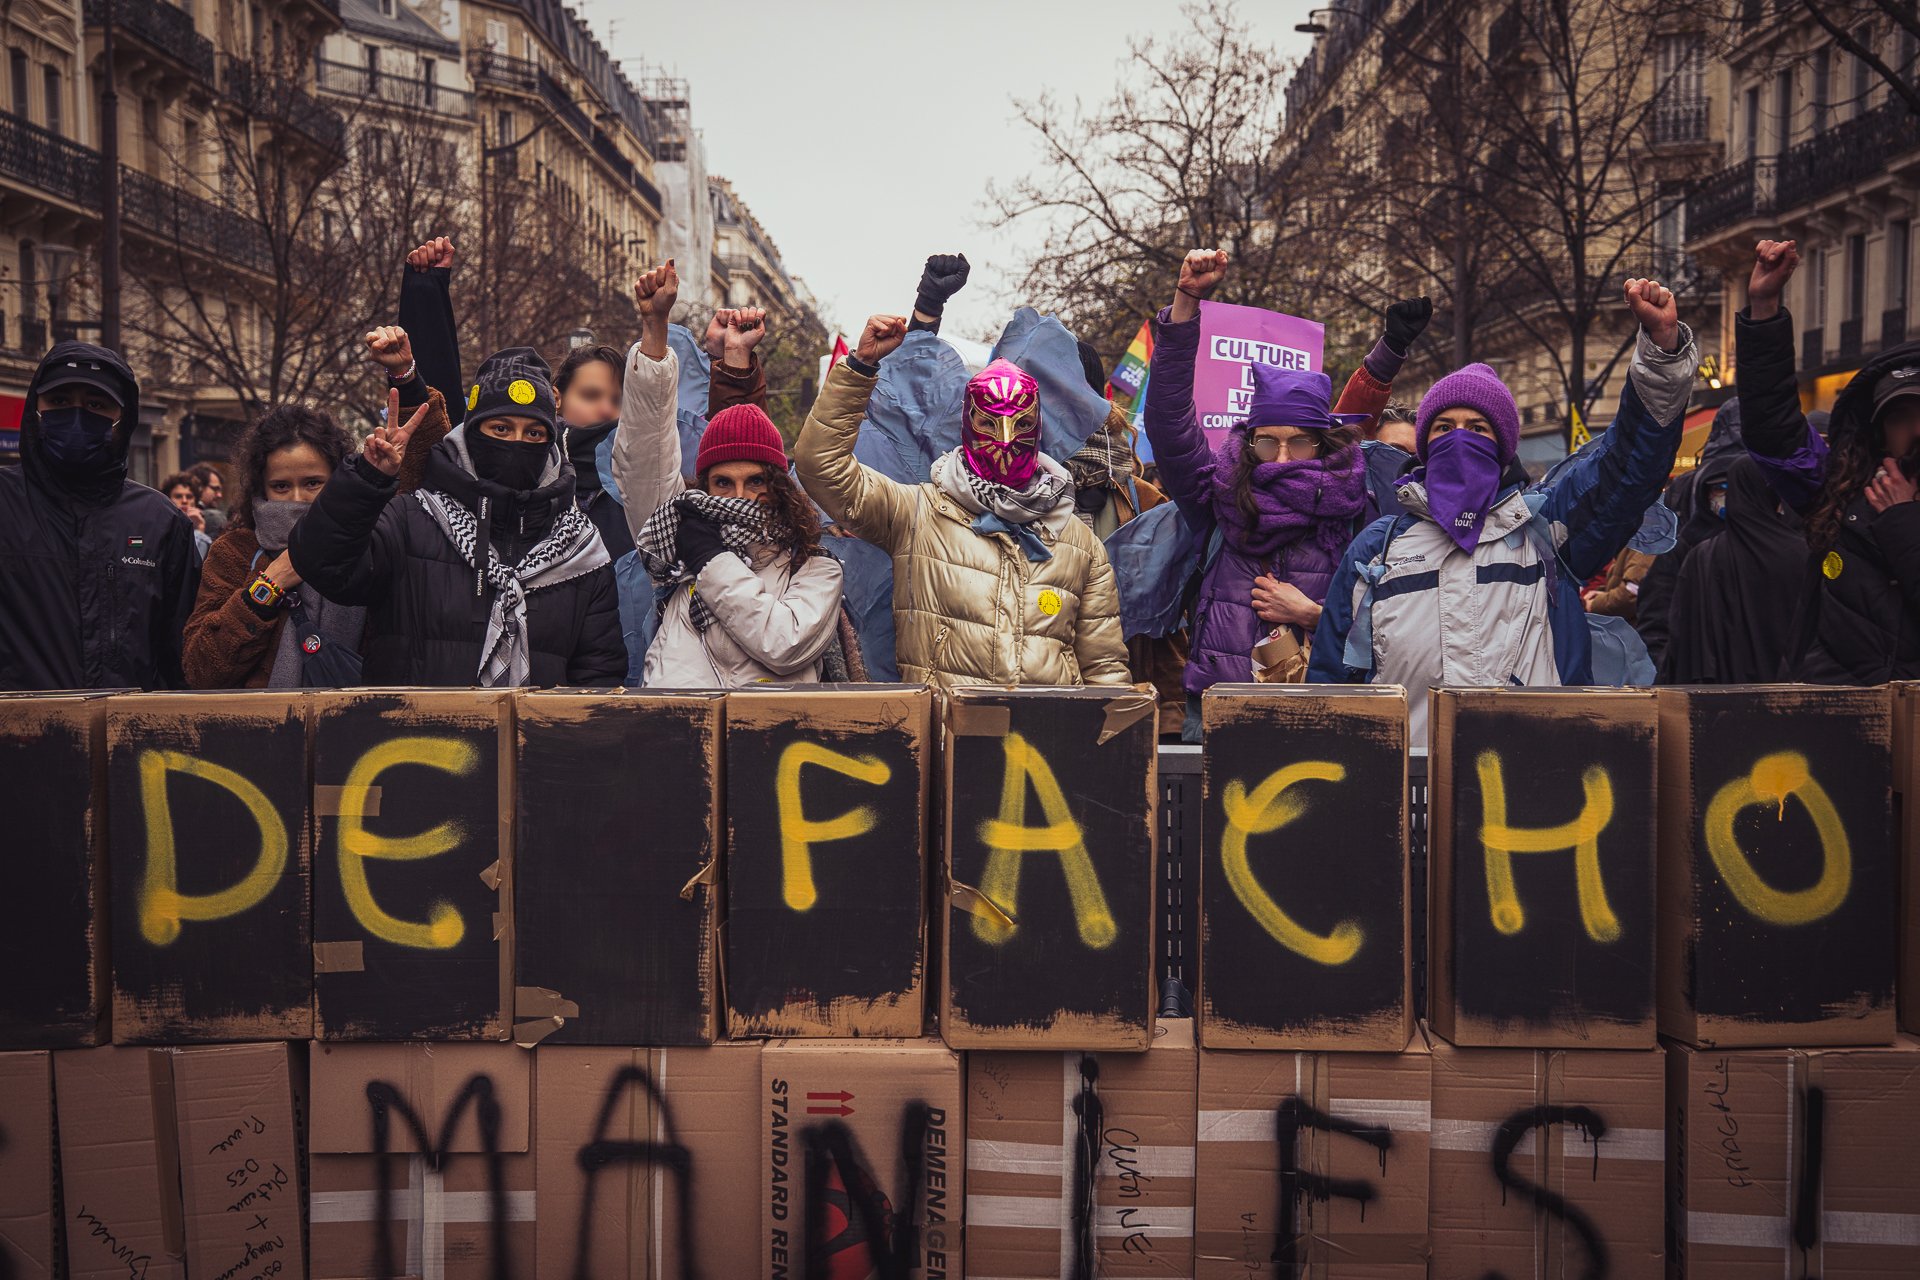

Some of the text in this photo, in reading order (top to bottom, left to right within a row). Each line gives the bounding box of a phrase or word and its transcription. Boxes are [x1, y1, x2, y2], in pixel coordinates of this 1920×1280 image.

[489, 355, 525, 370] THE
[1215, 338, 1306, 371] CULTURE
[127, 556, 156, 568] Columbia
[138, 729, 1855, 967] DE FACHO
[771, 1078, 789, 1221] STANDARD
